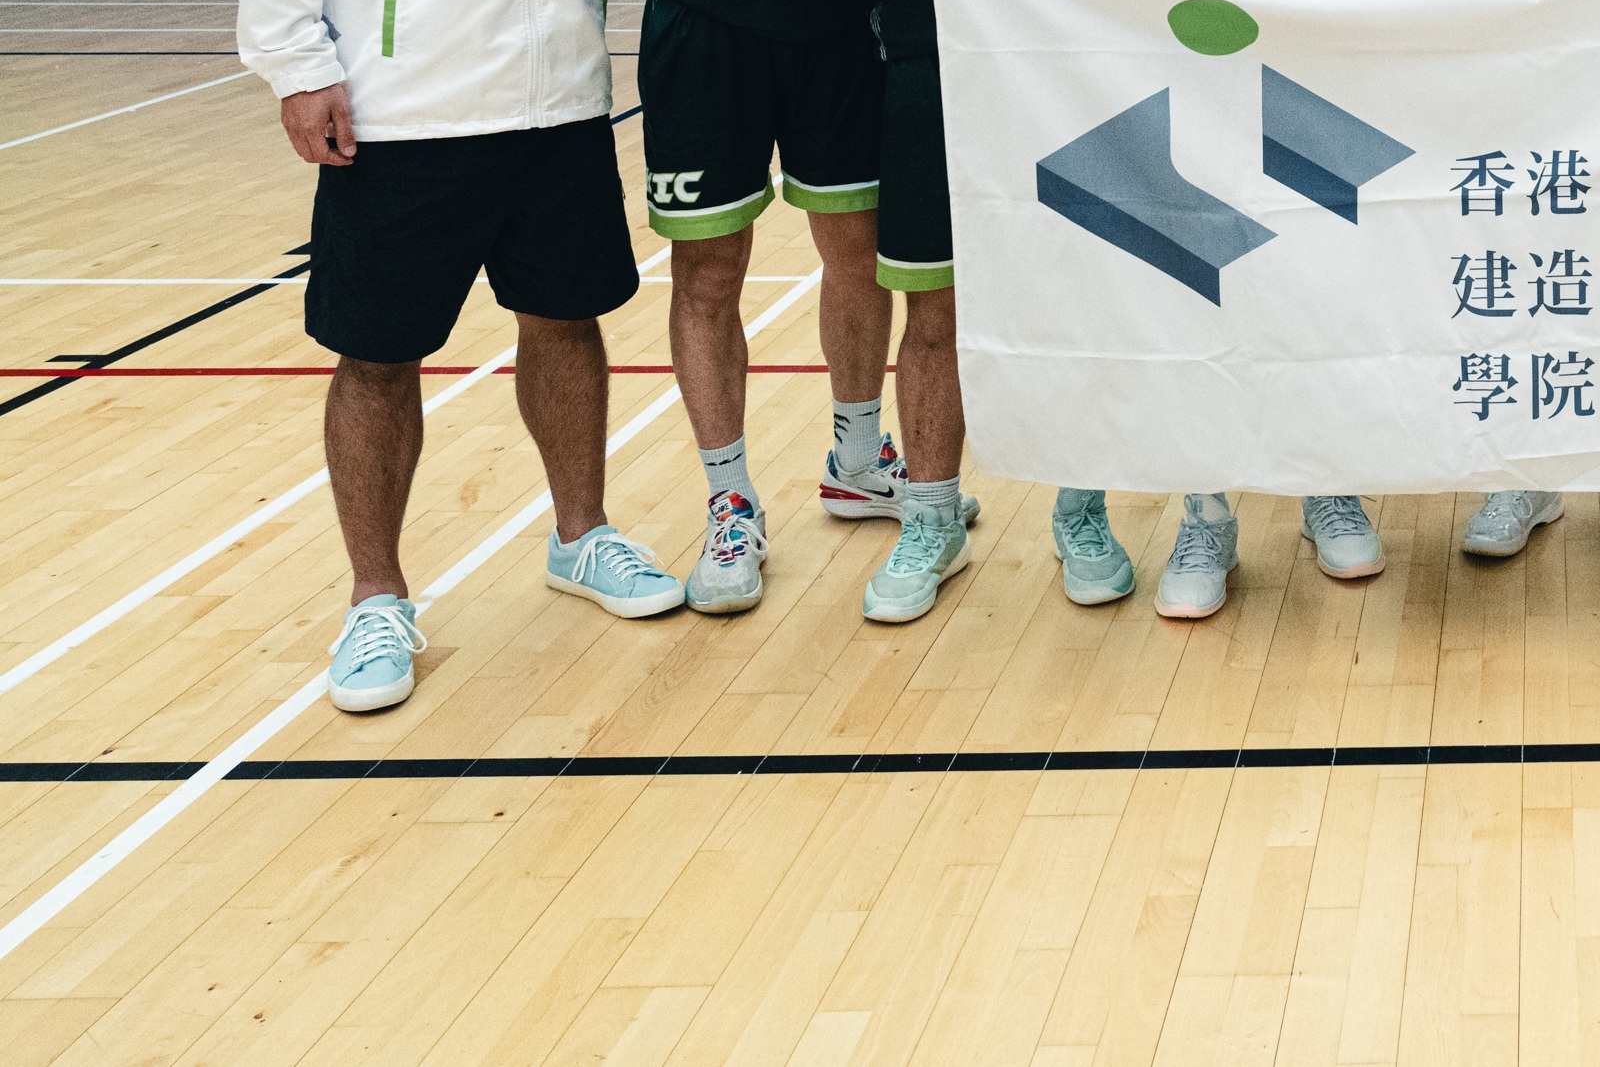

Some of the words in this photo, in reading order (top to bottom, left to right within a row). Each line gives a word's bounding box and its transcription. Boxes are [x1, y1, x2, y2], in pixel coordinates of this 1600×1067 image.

[646, 167, 705, 204] IC
[1449, 149, 1593, 217] 香港
[1450, 248, 1594, 320] 建造
[1453, 350, 1597, 421] 學院
